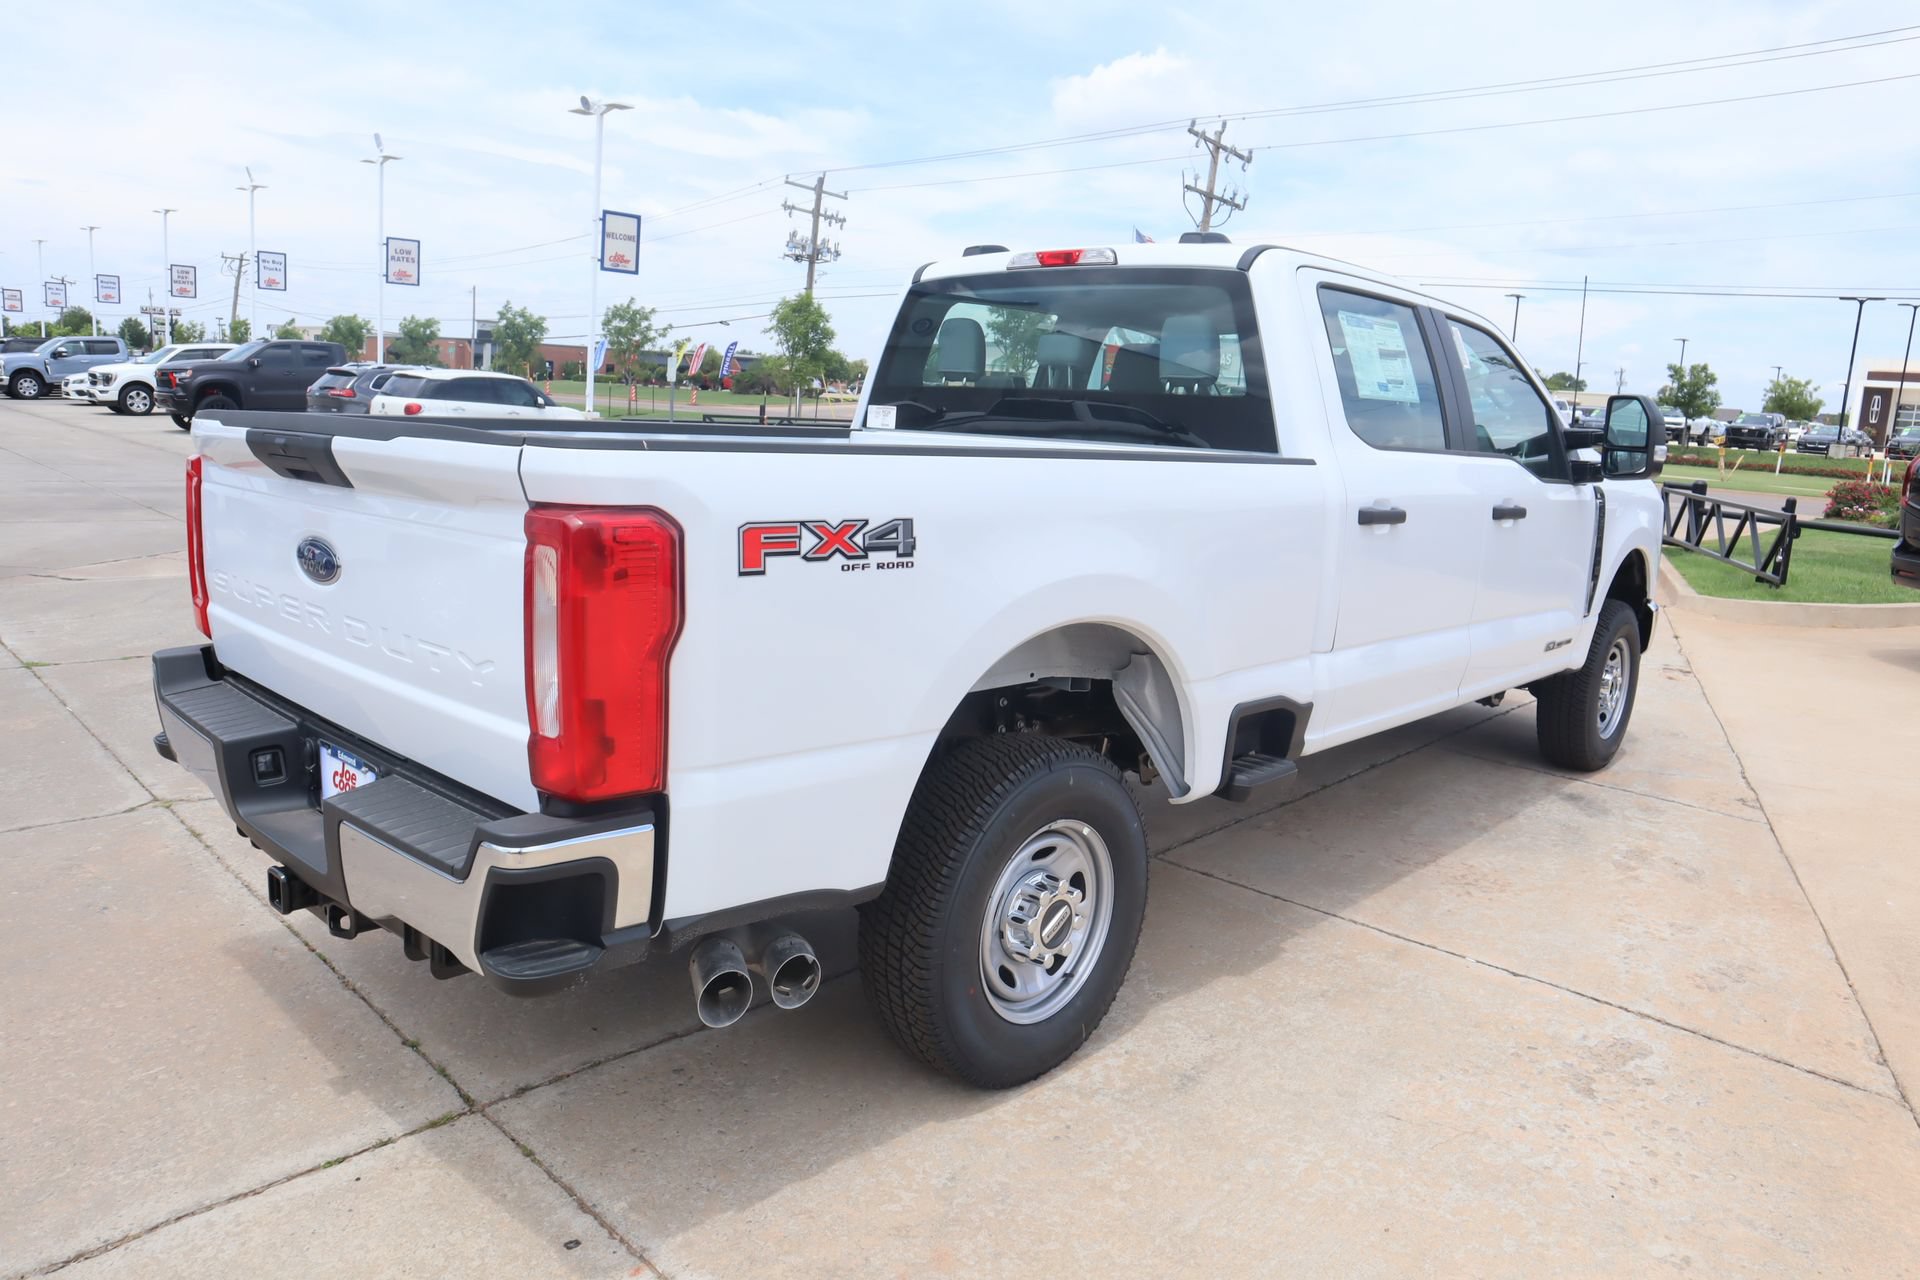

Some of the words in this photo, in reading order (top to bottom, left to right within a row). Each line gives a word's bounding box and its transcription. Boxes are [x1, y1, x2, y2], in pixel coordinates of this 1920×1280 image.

[605, 231, 636, 243] WELCOME
[390, 255, 416, 264] RATES
[394, 248, 412, 256] LOW
[722, 344, 736, 376] PINBALL
[738, 518, 916, 577] FX4
[841, 563, 871, 572] OFF
[876, 561, 915, 570] ROAD
[214, 568, 331, 634] SUPER
[343, 614, 496, 687] DUTY
[340, 761, 357, 786] Joe
[1046, 911, 1068, 939] FORD
